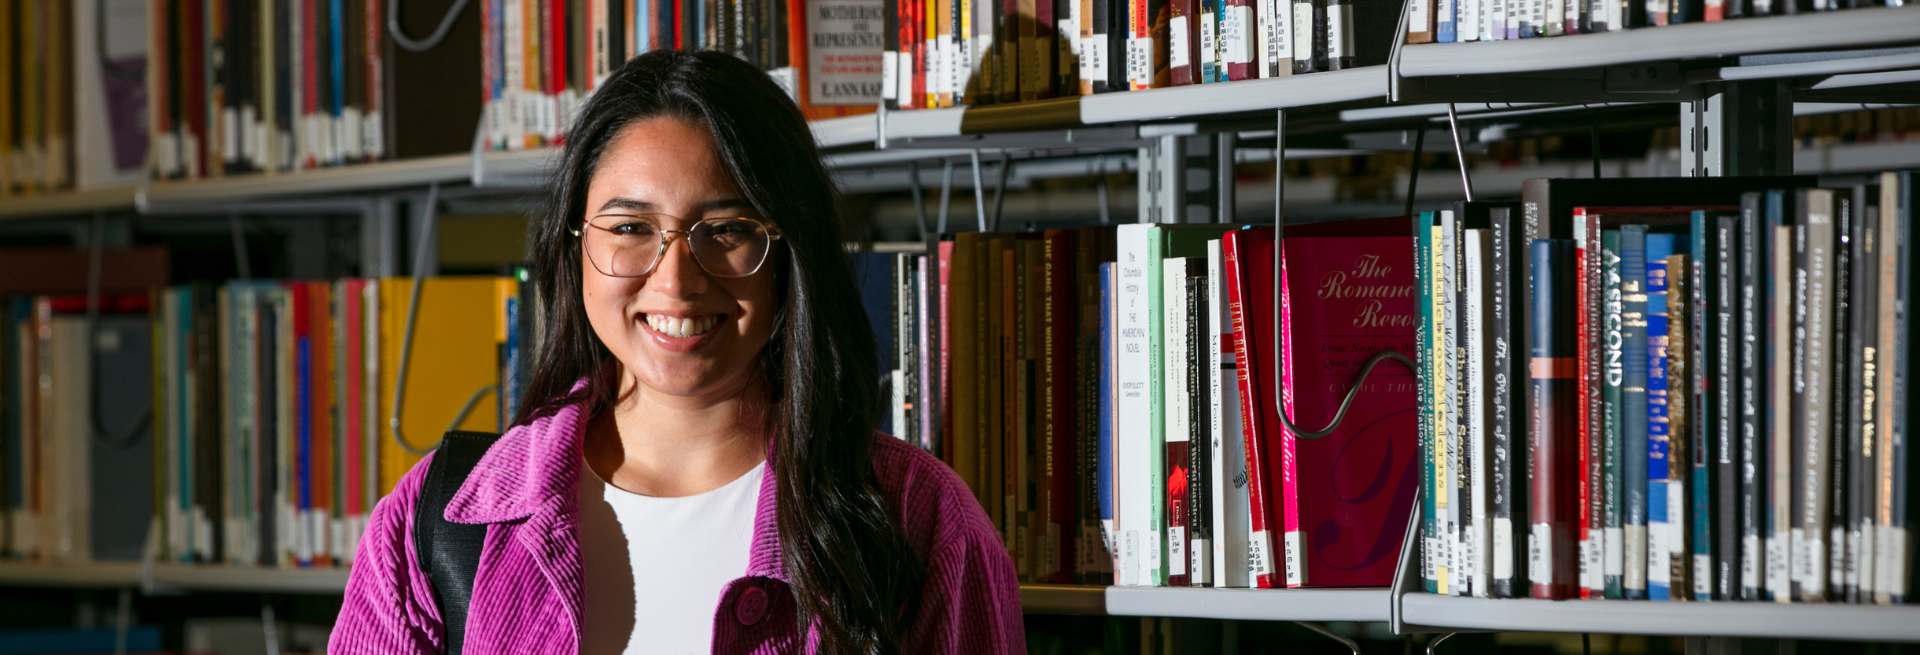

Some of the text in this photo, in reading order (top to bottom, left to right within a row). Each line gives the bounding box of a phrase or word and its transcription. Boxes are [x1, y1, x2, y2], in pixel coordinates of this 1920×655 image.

[1494, 223, 1502, 258] JULIA
[1045, 262, 1053, 292] GANG
[1351, 254, 1392, 279] The
[1317, 270, 1414, 299] Romanc
[1045, 295, 1053, 323] THAT
[1188, 290, 1196, 314] The
[1435, 236, 1444, 379] Middlebrow
[1122, 328, 1145, 338] AMERICAN
[1126, 343, 1140, 353] NOVEL
[1188, 316, 1197, 361] Eternal
[1320, 343, 1347, 353] Erotic
[1350, 342, 1380, 353] Novels
[1415, 326, 1424, 357] Voices
[1606, 288, 1623, 388] SECOND
[1045, 326, 1053, 384] WOULDN'T
[1322, 358, 1348, 369] Quest
[1495, 337, 1507, 366] The
[1189, 363, 1197, 397] Adam
[1416, 367, 1424, 381] of
[1443, 264, 1454, 471] DEAD WOMEN TALKING
[1456, 347, 1466, 419] Sharing
[1416, 385, 1425, 402] the
[1493, 373, 1507, 420] Plight
[1590, 239, 1602, 530] Conversations with American Novelists
[1045, 386, 1053, 420] WRITE
[1427, 397, 1434, 411] OF
[1190, 421, 1198, 445] New
[1437, 384, 1447, 490] Moderns
[1493, 425, 1506, 441] of
[1605, 402, 1614, 467] MALCOLM
[1457, 424, 1467, 489] Secrets
[1191, 483, 1199, 527] Garden
